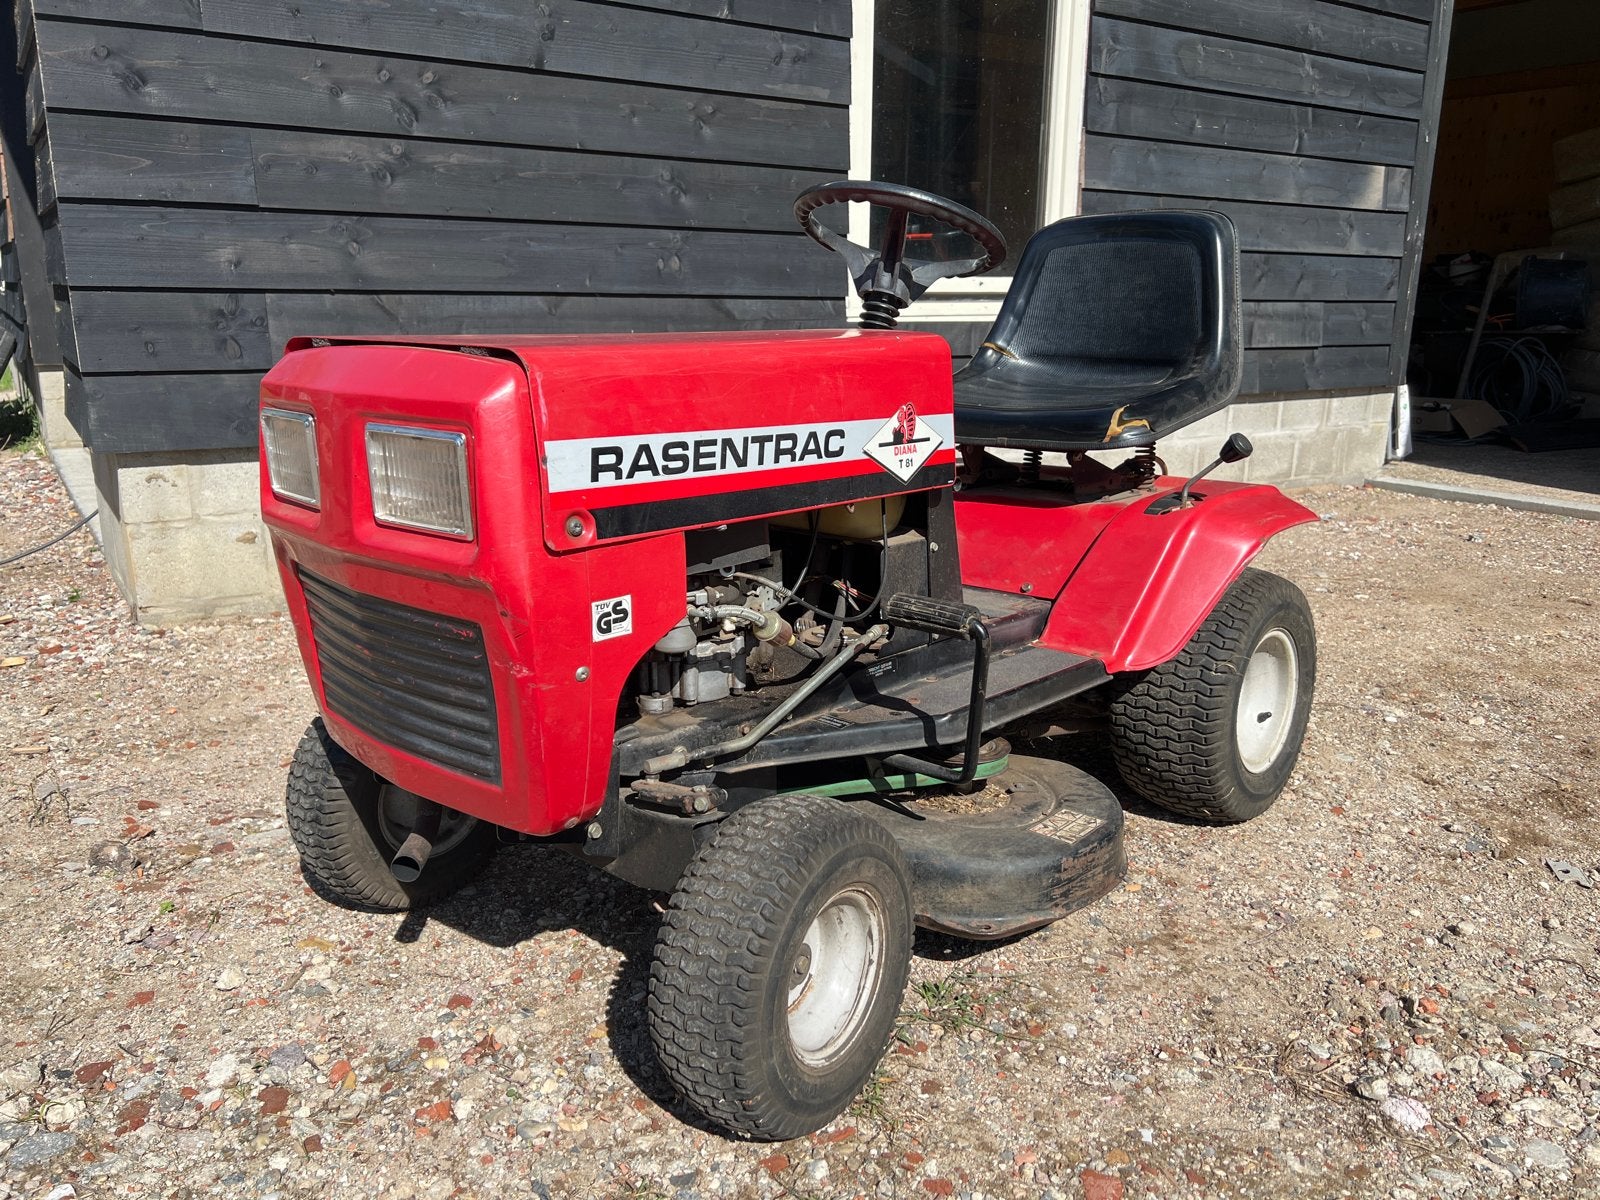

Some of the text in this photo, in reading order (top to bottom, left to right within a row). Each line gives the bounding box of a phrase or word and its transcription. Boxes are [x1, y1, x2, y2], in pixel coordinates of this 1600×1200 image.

[590, 429, 846, 483] RASENTRAC
[893, 444, 918, 456] DIANA
[898, 459, 904, 469] T
[596, 600, 629, 634] GS
